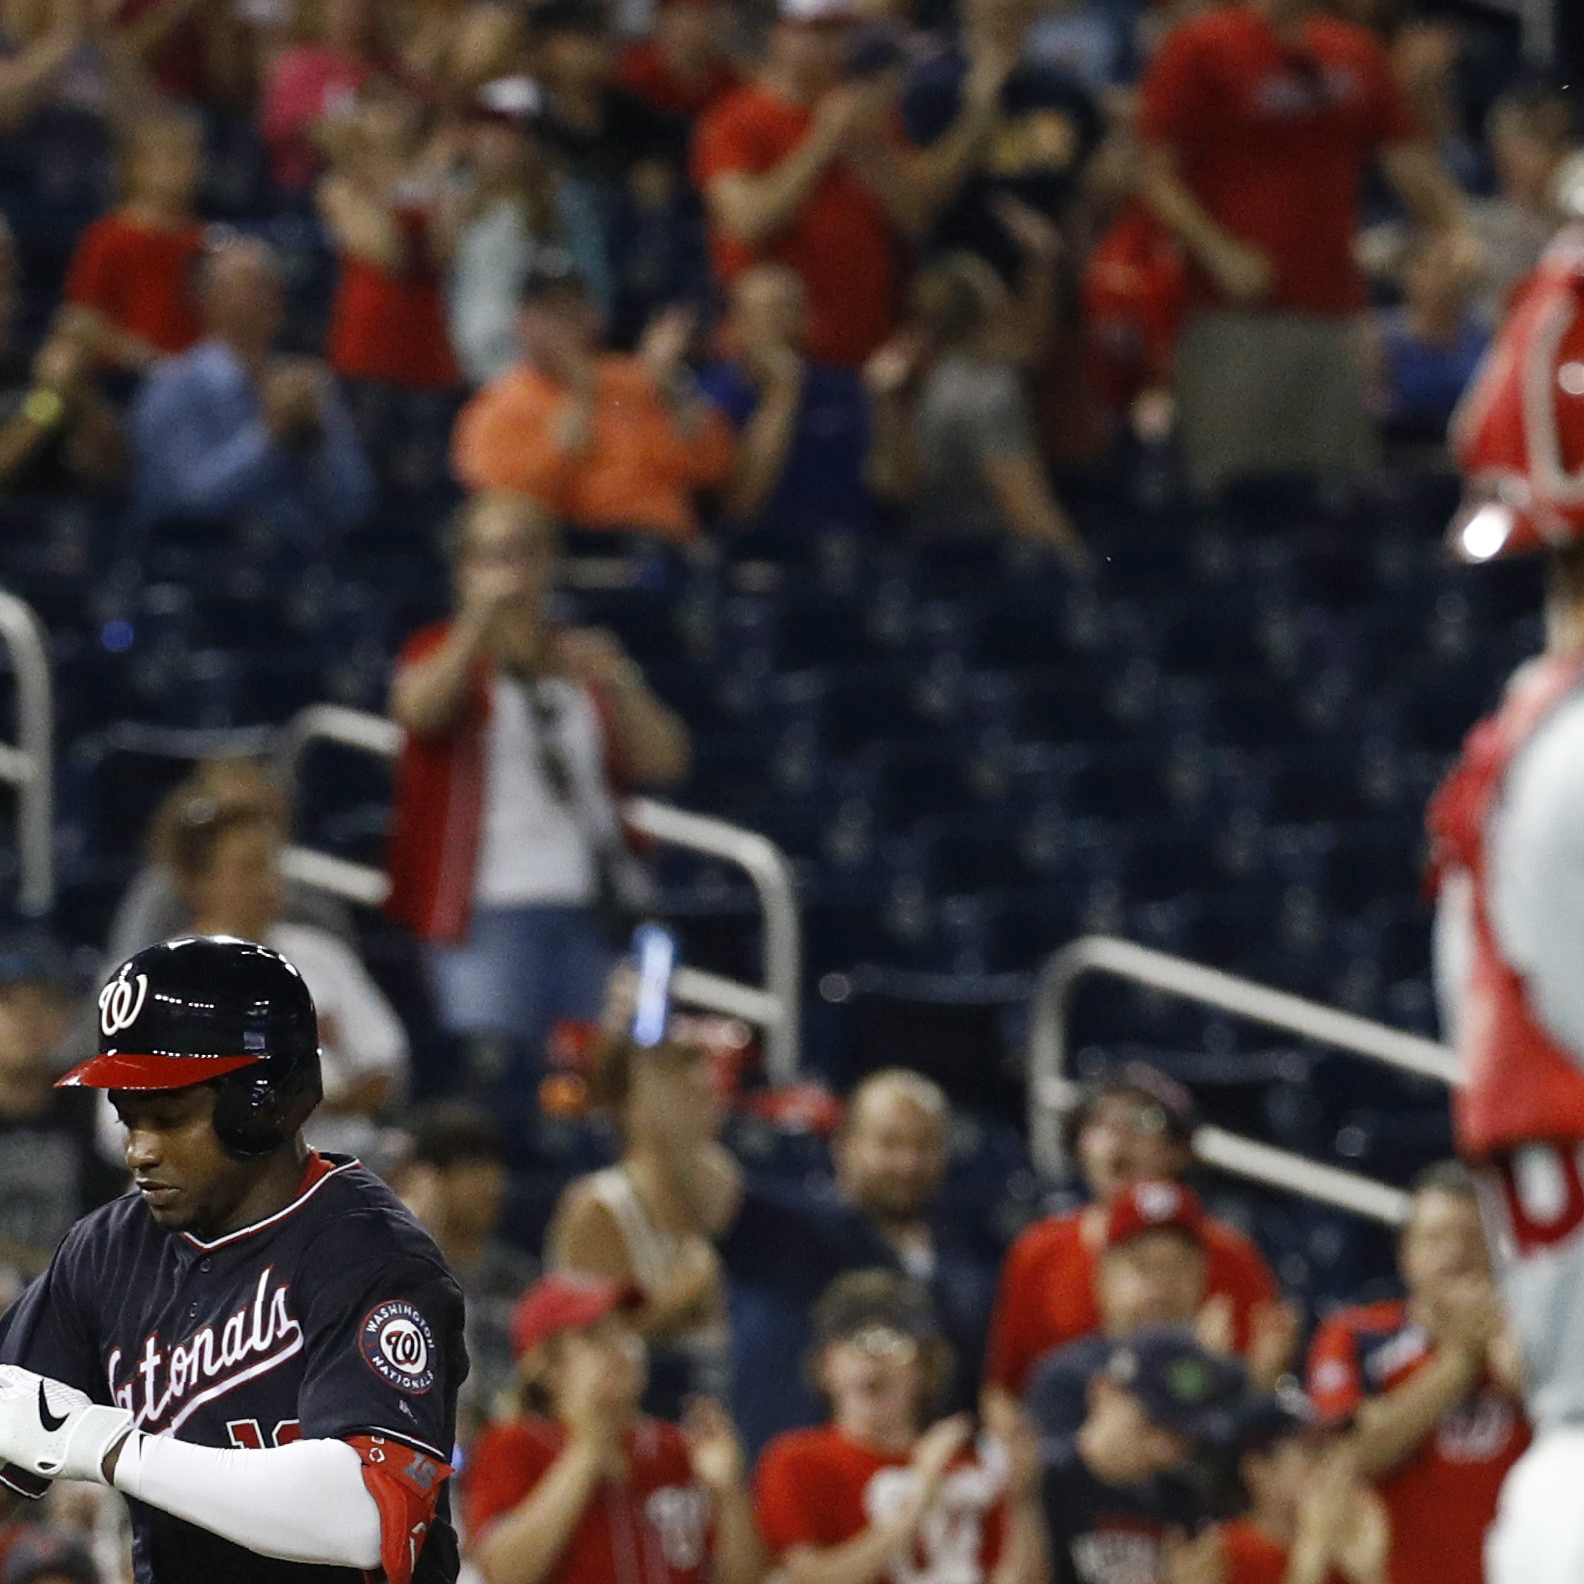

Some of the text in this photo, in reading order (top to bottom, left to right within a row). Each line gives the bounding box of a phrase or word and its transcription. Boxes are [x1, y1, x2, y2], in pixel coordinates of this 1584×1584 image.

[98, 973, 148, 1036] W
[365, 1303, 435, 1349] WASHINGTON
[385, 1330, 421, 1366] W
[372, 1355, 434, 1390] NATIONALS
